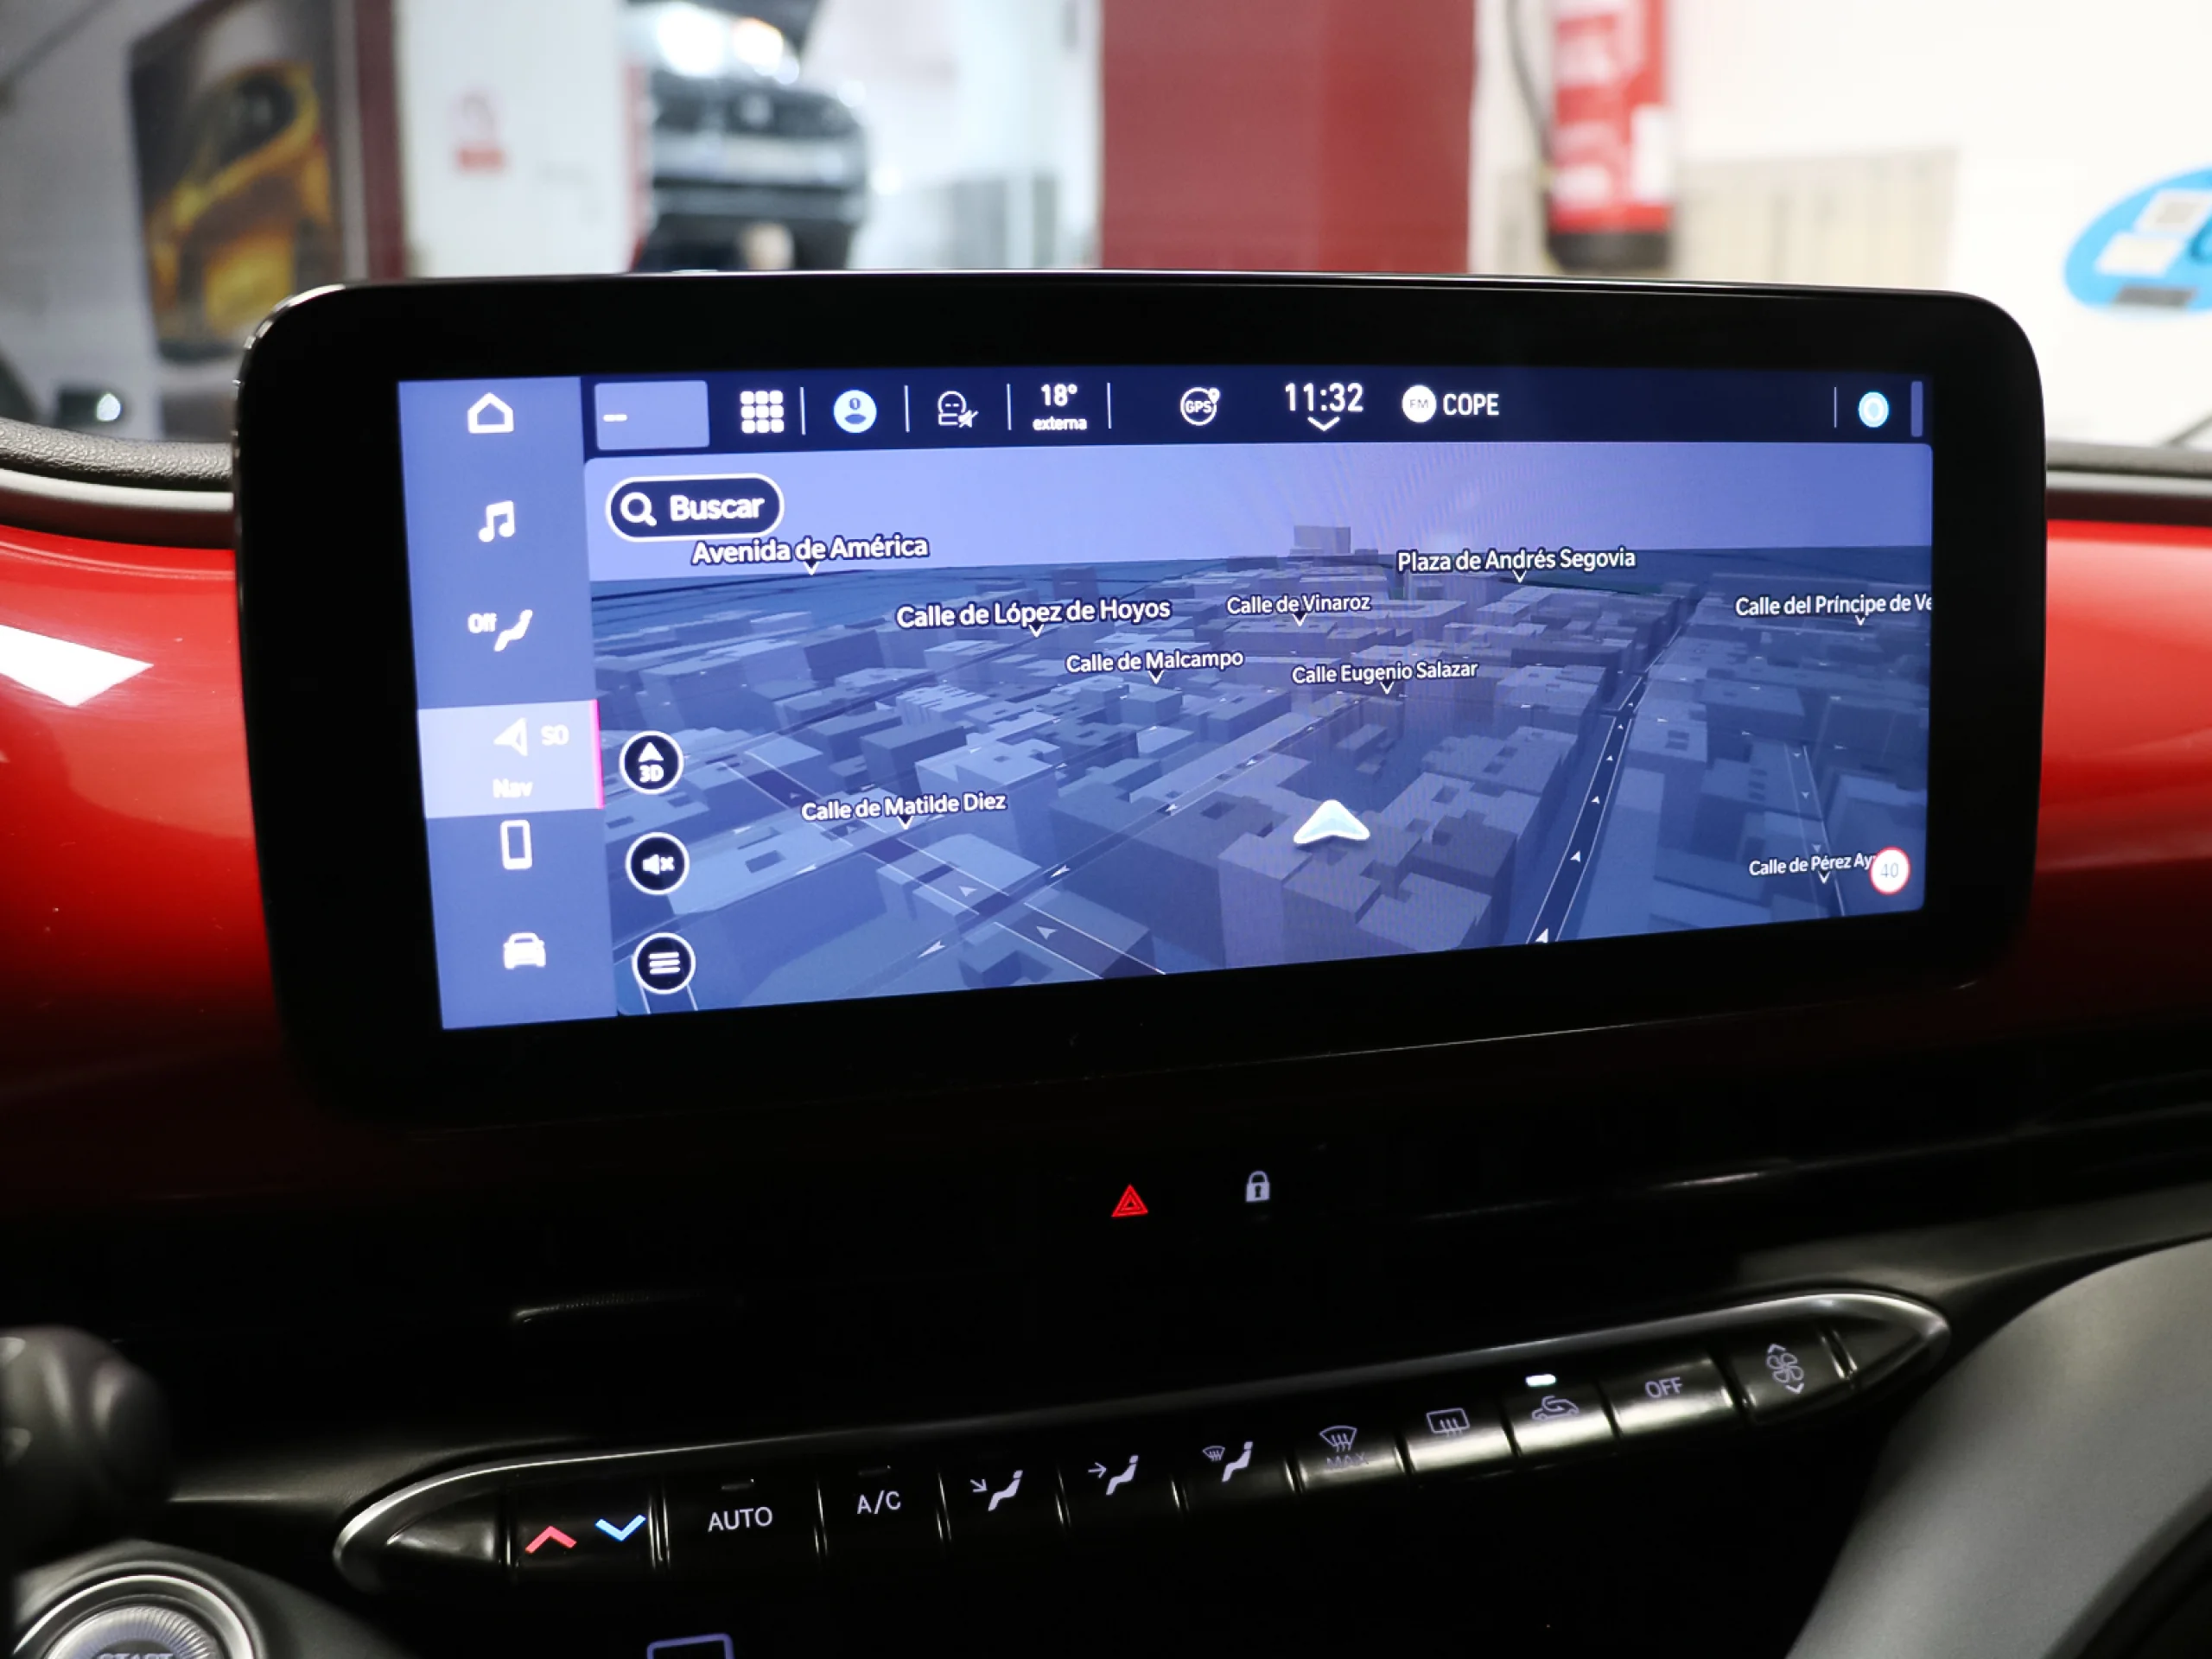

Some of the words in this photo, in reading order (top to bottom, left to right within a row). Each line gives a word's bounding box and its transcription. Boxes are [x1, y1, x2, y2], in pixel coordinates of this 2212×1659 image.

[1040, 383, 1078, 406] 18°
[1285, 382, 1364, 412] 11:32
[1409, 398, 1430, 409] FM
[1442, 393, 1500, 416] COPE
[1185, 400, 1212, 413] GPS
[1033, 416, 1088, 431] externa
[670, 494, 765, 521] Buscar
[692, 539, 791, 563] Avenida
[796, 537, 827, 560] de
[829, 533, 929, 559] América
[1398, 551, 1452, 571] Plaza
[1455, 550, 1481, 570] de
[1484, 549, 1556, 569] Andrés
[1560, 548, 1637, 571] Segovia
[896, 606, 956, 628] Calle
[959, 603, 989, 625] de
[995, 601, 1064, 627] López
[1066, 600, 1095, 621] de
[1099, 599, 1171, 623] Hoyos
[1227, 596, 1273, 614] Calle
[1275, 594, 1300, 613] de
[1301, 594, 1371, 612] Vinaroz
[1735, 596, 1781, 616] Calle
[1783, 595, 1812, 614] del
[1815, 594, 1886, 616] Príncipe
[1890, 594, 1911, 612] de
[467, 612, 498, 634] Off
[1066, 653, 1114, 673] Calle
[1118, 652, 1141, 671] de
[1146, 651, 1244, 671] Malcampo
[1292, 666, 1337, 684] Calle
[1341, 662, 1413, 684] Eugenio
[1416, 661, 1479, 679] Salazar
[541, 724, 569, 746] SO
[639, 764, 664, 783] 3D
[493, 778, 533, 798] Nav
[801, 801, 852, 821] Calle
[855, 798, 890, 817] de
[893, 795, 959, 816] Matilde
[963, 791, 1007, 811] Diez
[1748, 858, 1787, 876] Calle
[1789, 856, 1808, 873] de
[1810, 855, 1853, 872] Pérez
[1879, 862, 1899, 878] 40
[1644, 1376, 1683, 1399] OFF
[857, 1490, 901, 1515] A/C
[708, 1506, 773, 1533] AUTO
